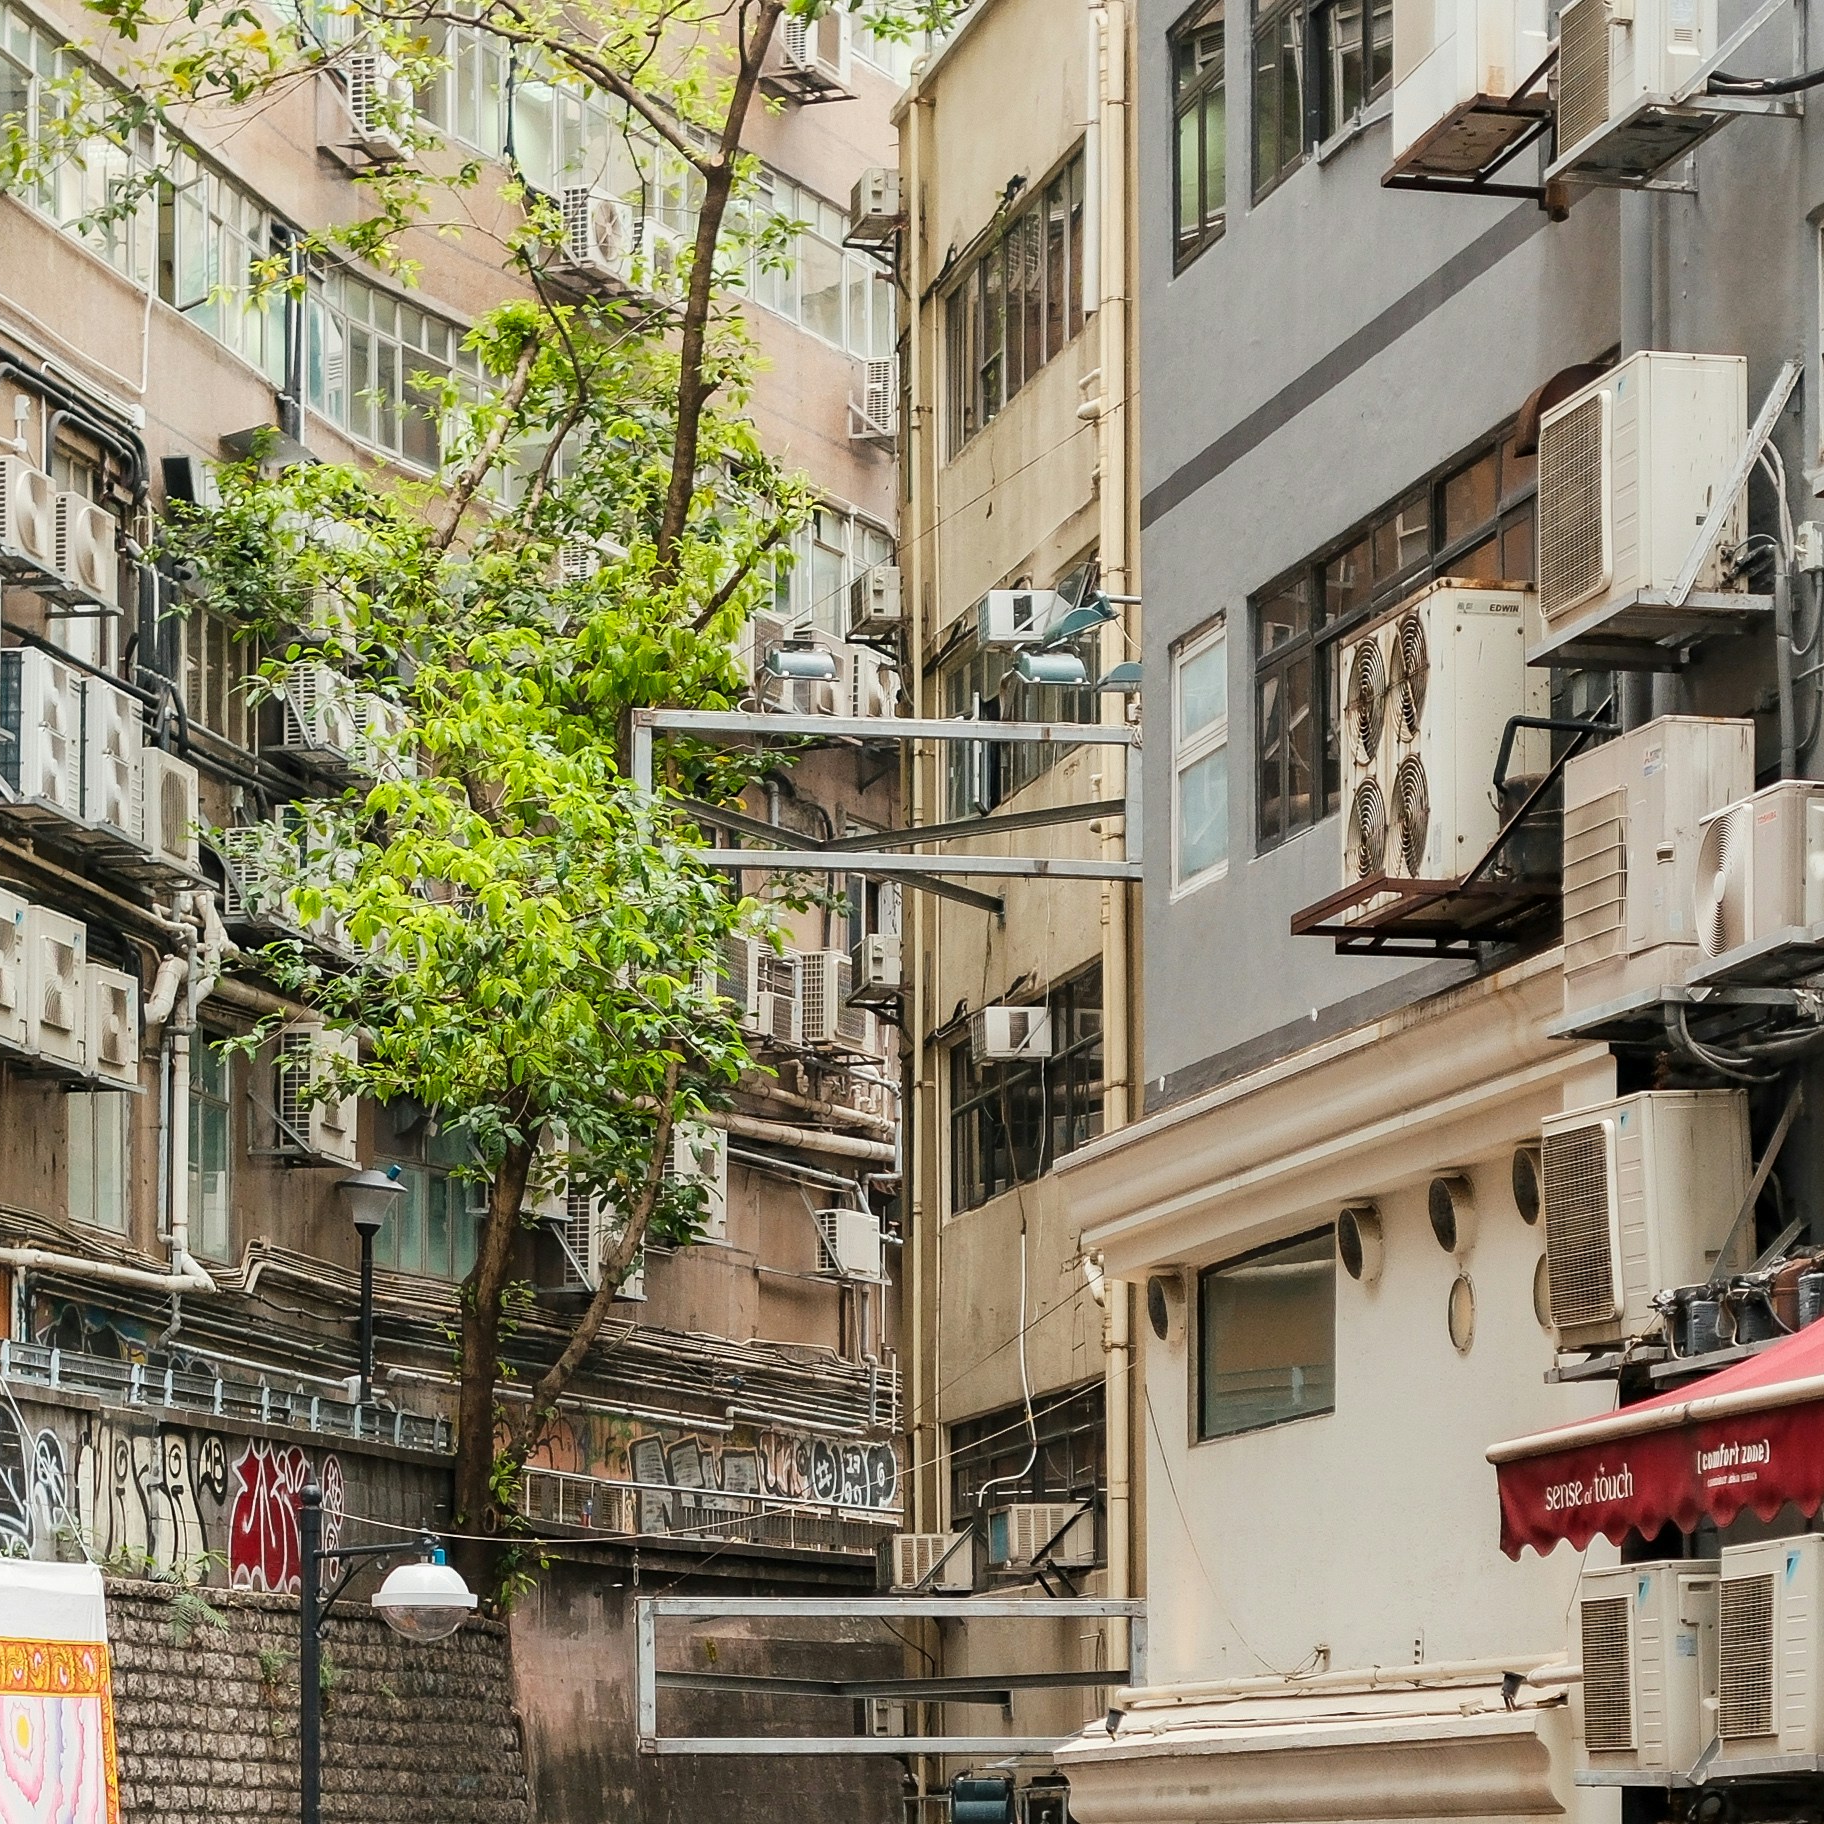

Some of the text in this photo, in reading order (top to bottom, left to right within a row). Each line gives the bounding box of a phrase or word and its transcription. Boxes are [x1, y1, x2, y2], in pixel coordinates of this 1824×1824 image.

[1488, 602, 1520, 614] EDWIN
[1545, 1462, 1634, 1512] sense of touch
